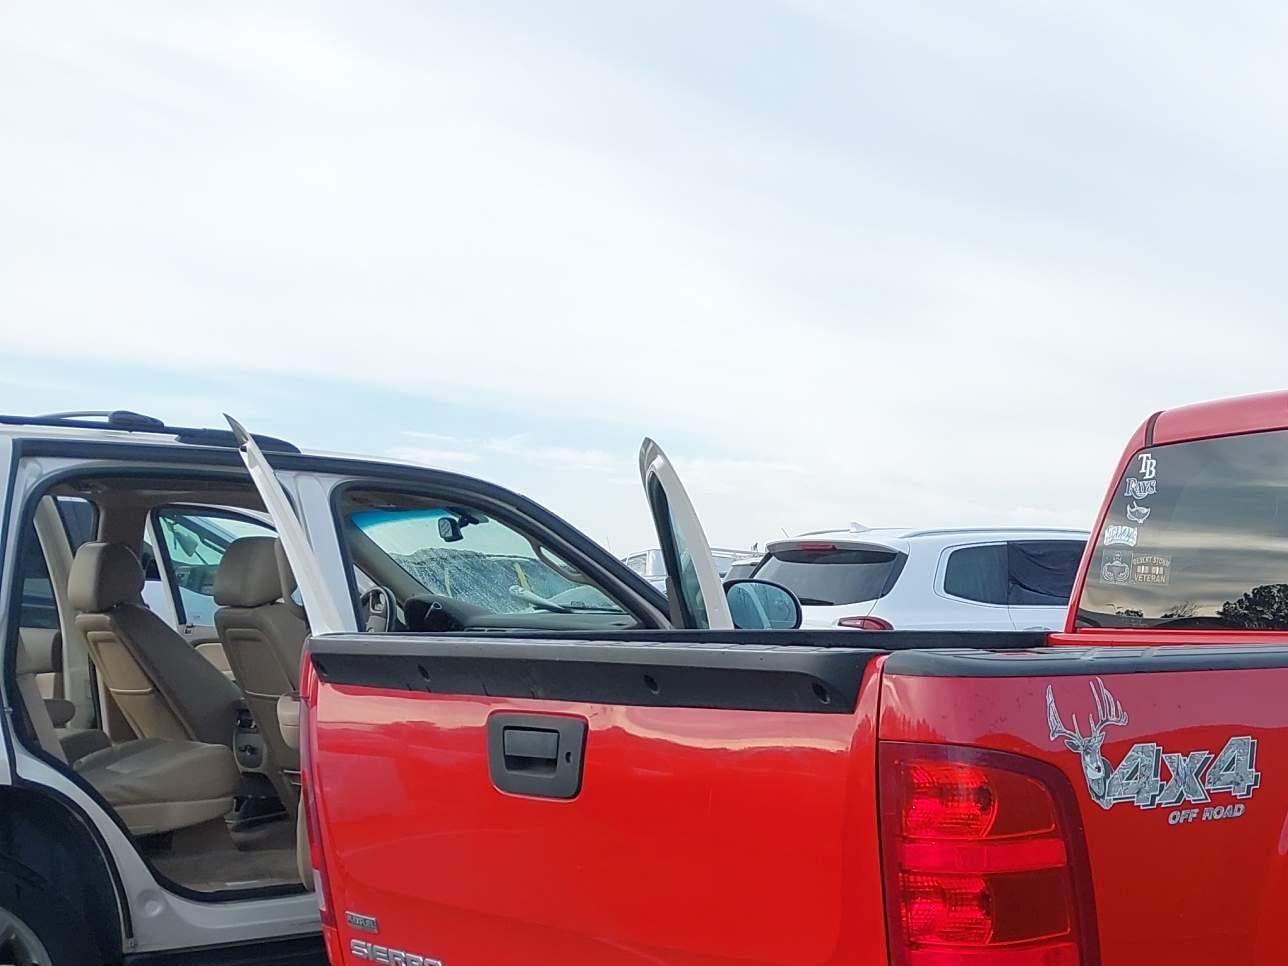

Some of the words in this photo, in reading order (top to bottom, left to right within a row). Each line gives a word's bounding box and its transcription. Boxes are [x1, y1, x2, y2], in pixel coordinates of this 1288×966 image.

[1135, 574, 1166, 584] VETERAN
[1168, 808, 1200, 825] OFF
[1202, 803, 1245, 822] ROAD
